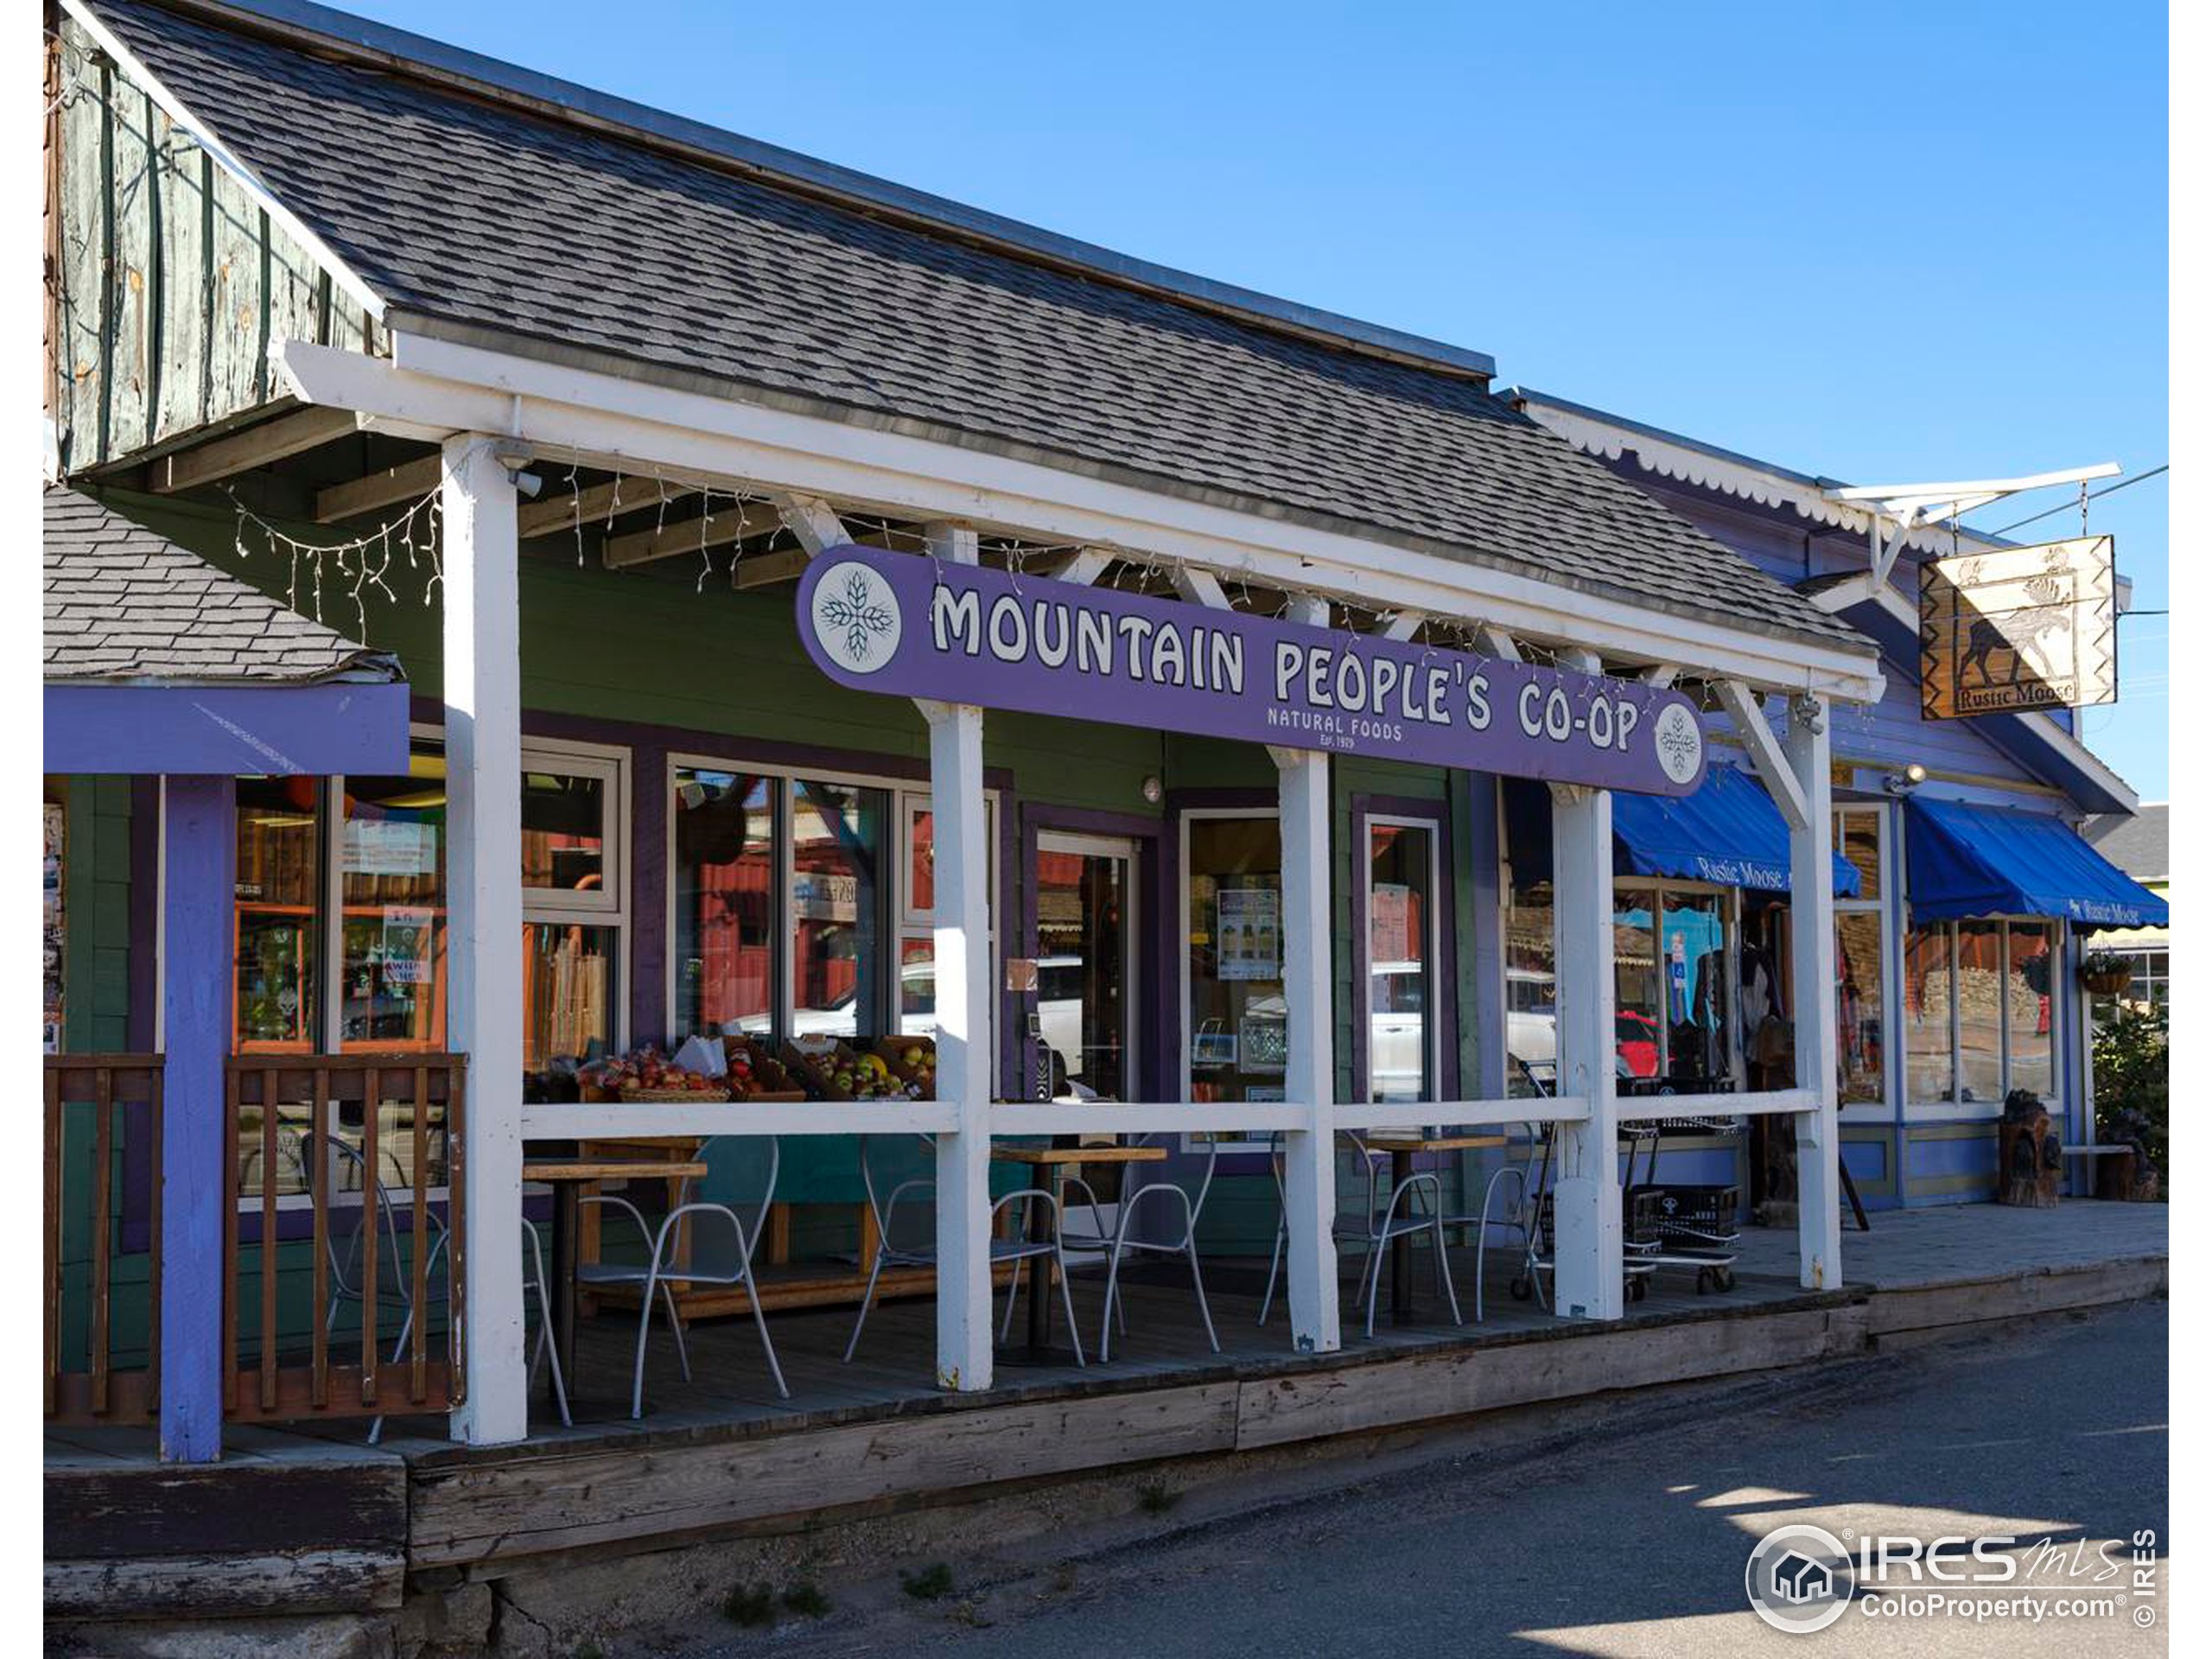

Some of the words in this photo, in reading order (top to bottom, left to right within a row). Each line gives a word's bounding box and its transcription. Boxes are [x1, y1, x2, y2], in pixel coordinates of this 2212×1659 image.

[932, 584, 1244, 695] MOUNTAIN
[1275, 640, 1491, 731] PEOPLE'S
[1518, 682, 1638, 752] CO-OP
[1961, 690, 2012, 708] Rustic
[2015, 682, 2073, 703] Moose
[1268, 708, 1343, 734] NATURAL
[1351, 719, 1402, 741] FOODS
[1697, 856, 1740, 883] Rustic
[1739, 861, 1783, 888] Moose
